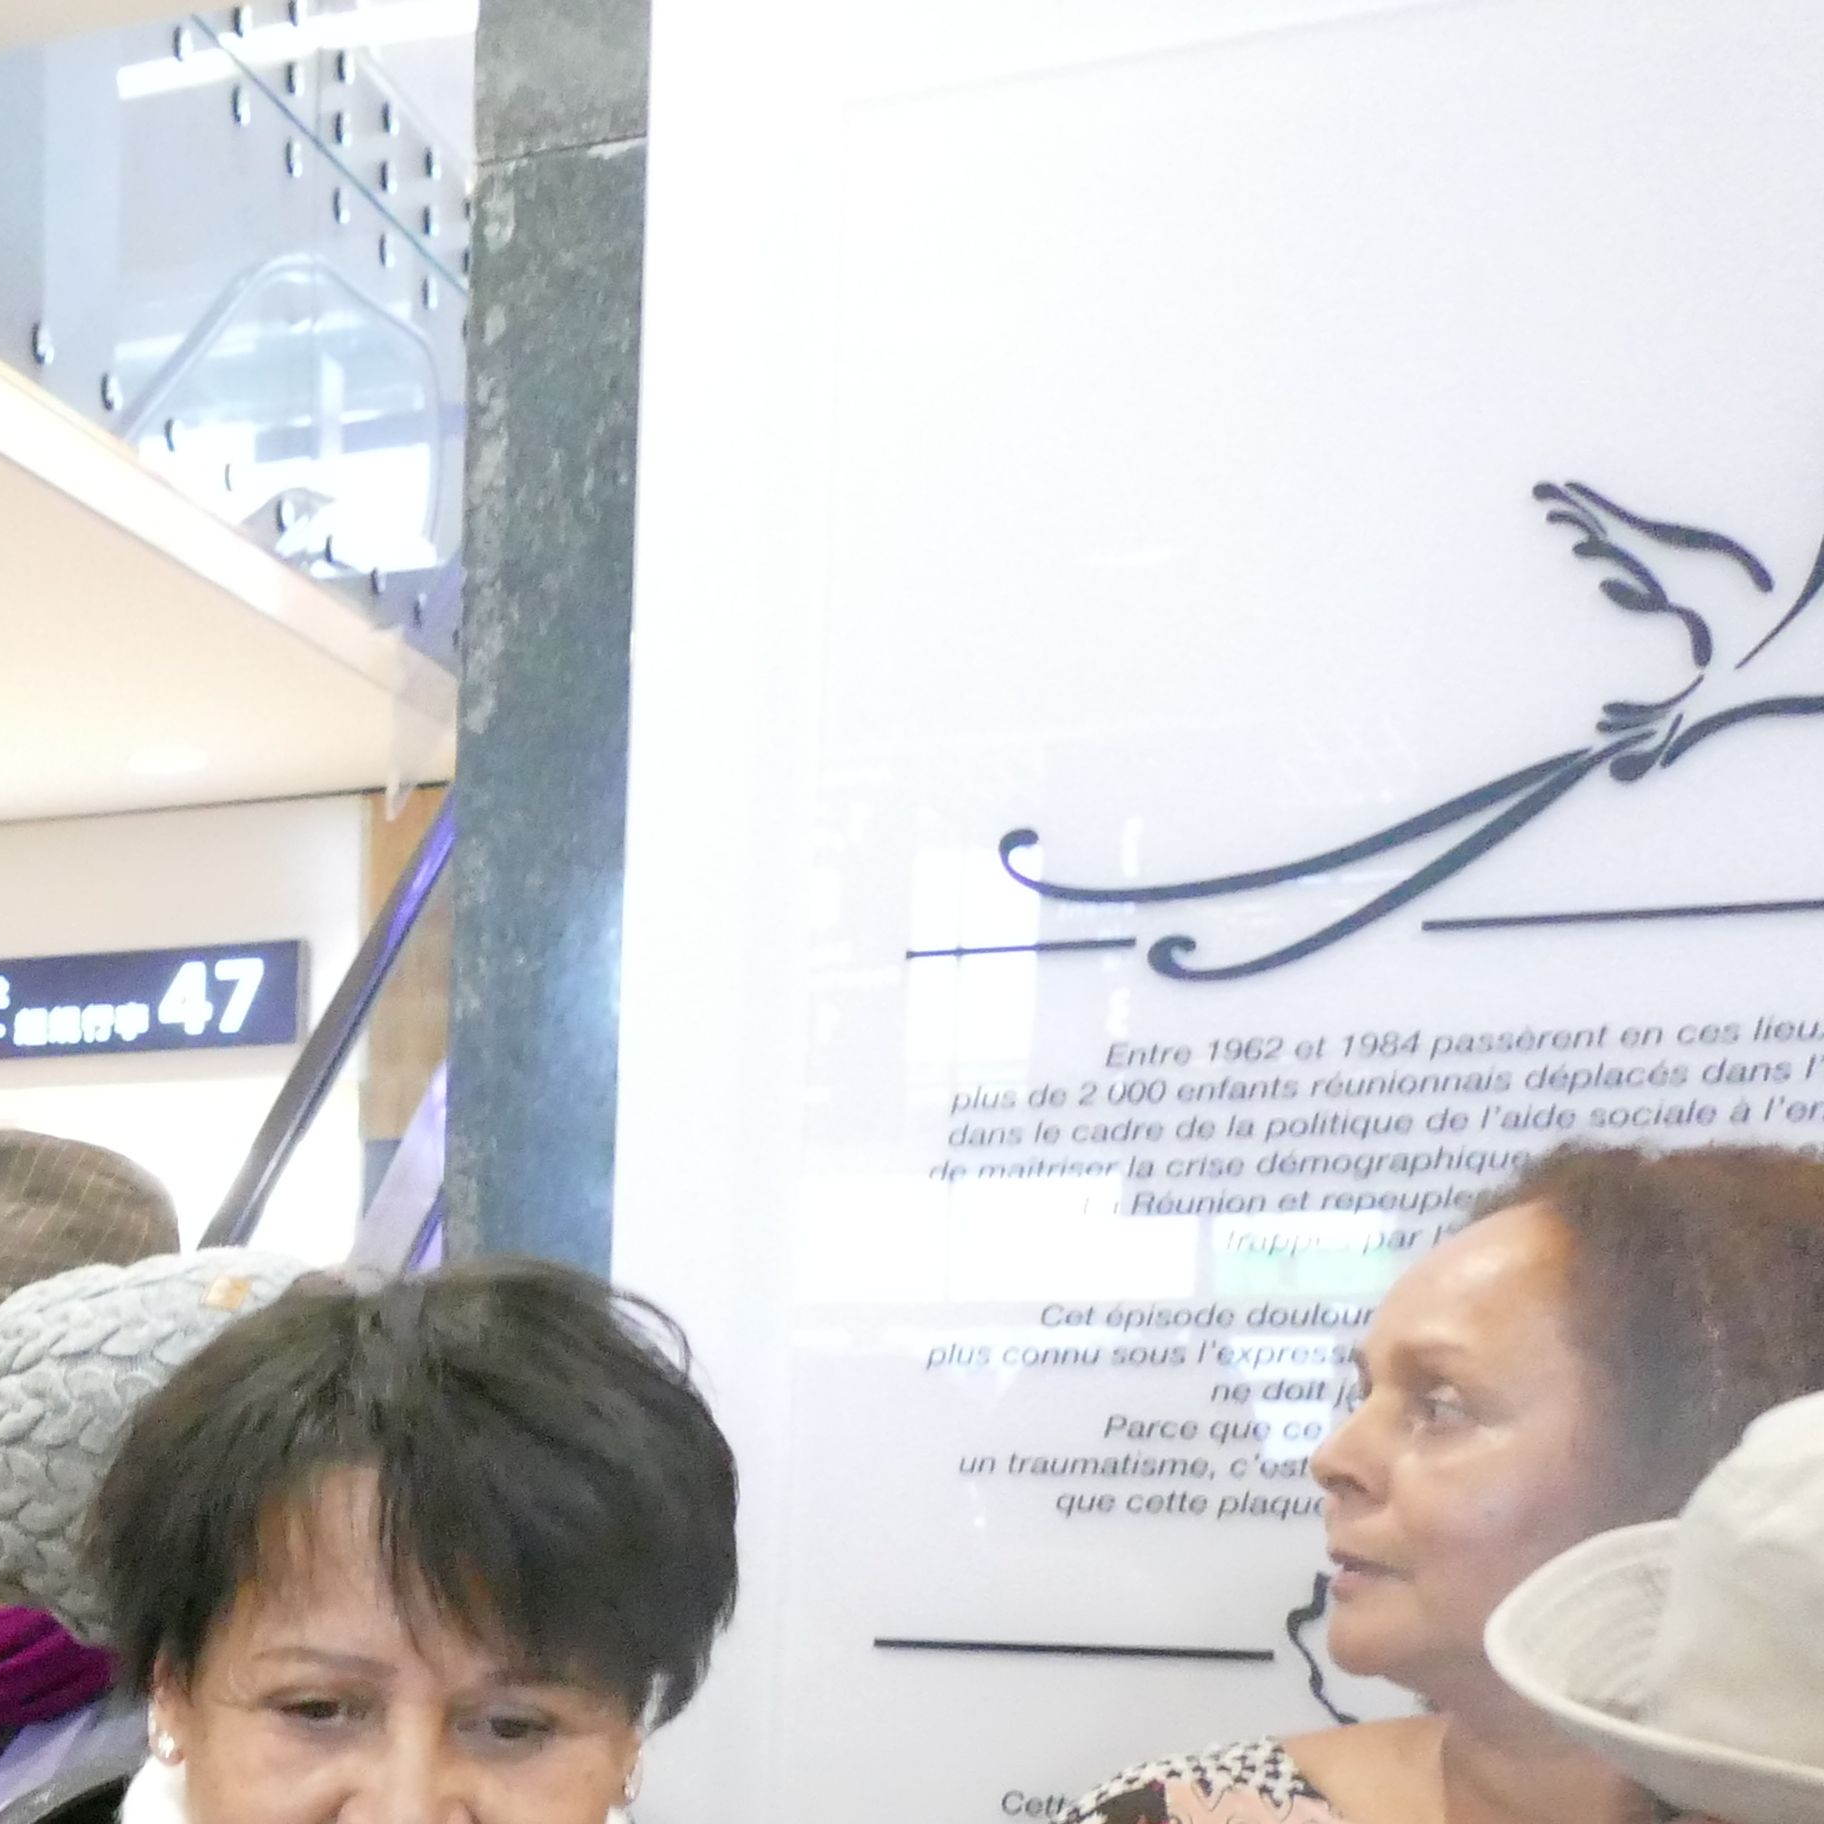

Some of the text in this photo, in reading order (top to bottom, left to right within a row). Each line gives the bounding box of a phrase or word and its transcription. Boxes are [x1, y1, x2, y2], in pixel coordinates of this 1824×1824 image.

[157, 957, 266, 1036] 47
[1105, 1014, 1824, 1068] Entre 1962 et 1984 passèrent en ces lieu
[950, 1086, 1017, 1117] plus
[1028, 1083, 1068, 1110] de
[1078, 1081, 1099, 1107] 2
[1107, 1079, 1168, 1106] 000
[1177, 1074, 1299, 1103] enfants
[1311, 1066, 1512, 1098] réunionnais
[1524, 1058, 1689, 1095] déplacés
[1702, 1057, 1792, 1085] dans
[949, 1122, 1022, 1147] dans
[1034, 1121, 1061, 1145] le
[1071, 1116, 1164, 1144] cadre
[1175, 1115, 1216, 1141] de
[1226, 1113, 1254, 1139] la
[1264, 1108, 1414, 1143] politique
[1426, 1107, 1470, 1134] de
[1481, 1102, 1577, 1132] l'aide
[1589, 1099, 1718, 1129] sociale
[1730, 1096, 1752, 1124] à
[1128, 1156, 1154, 1180] la
[1165, 1154, 1245, 1180] crise
[1256, 1146, 1532, 1181] démographique
[1131, 1189, 1267, 1217] Réunion
[1278, 1186, 1310, 1212] et
[1041, 1300, 1377, 1332] Cet épisode doulour
[926, 1339, 1360, 1370] plus connu sous l'expressi
[1210, 1380, 1251, 1404] ne
[1261, 1376, 1326, 1402] doit
[1103, 1414, 1323, 1446] Parce que ce
[959, 1449, 1309, 1481] un traumatisme, c'est
[1055, 1491, 1116, 1518] que
[1126, 1488, 1208, 1515] cette
[1001, 1789, 1074, 1818] Cett
